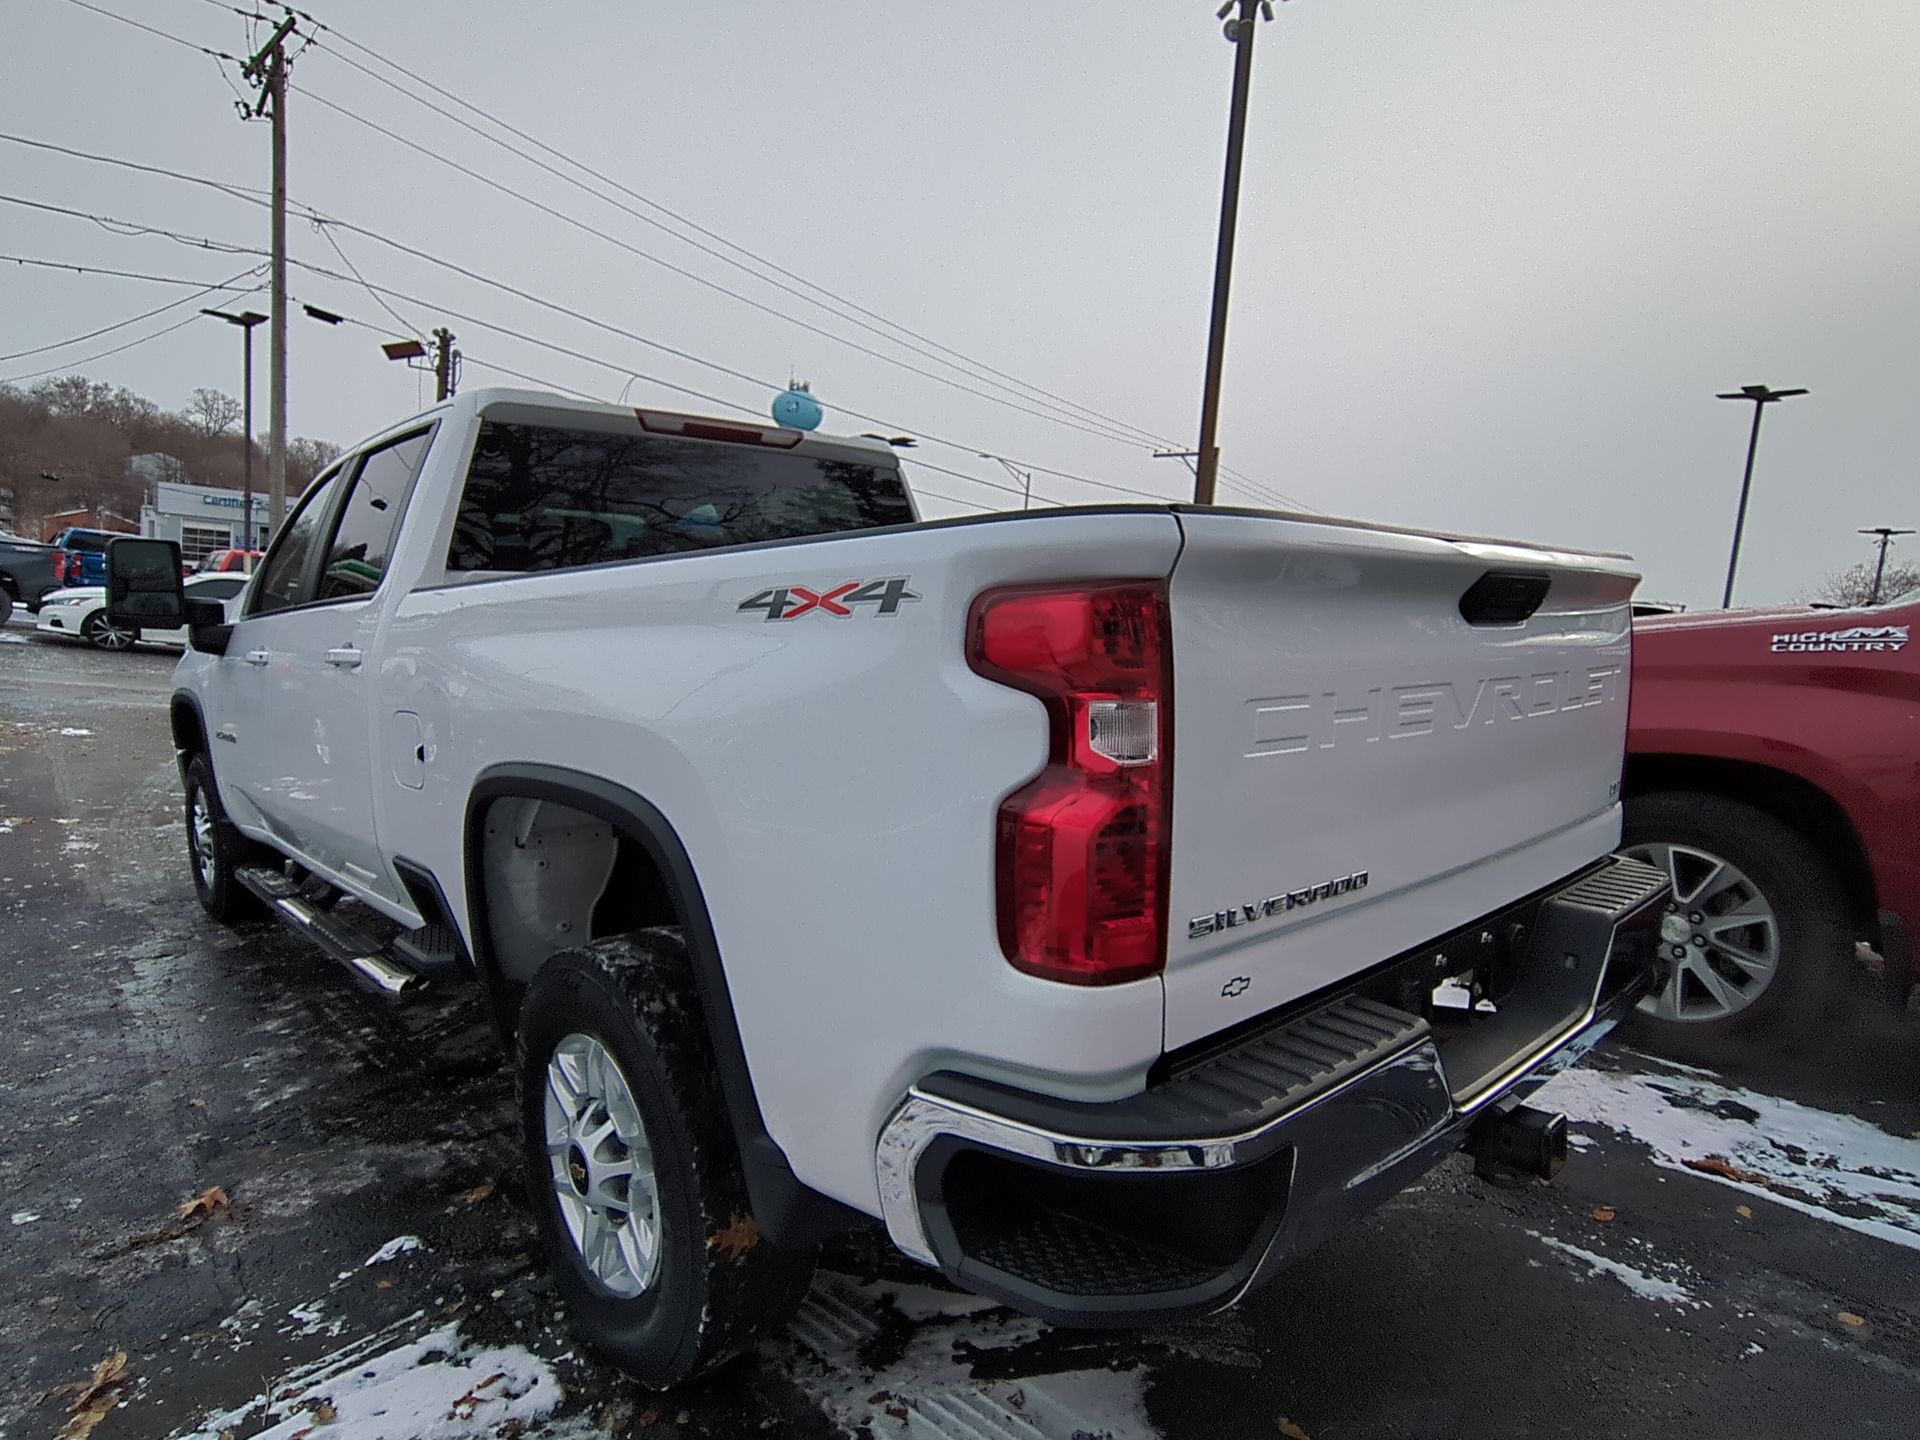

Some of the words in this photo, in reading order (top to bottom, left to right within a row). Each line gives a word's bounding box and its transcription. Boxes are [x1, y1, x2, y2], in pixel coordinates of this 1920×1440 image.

[1771, 632, 1837, 643] HIGH
[1771, 642, 1906, 652] COUNTRY
[1243, 665, 1622, 758] CHEVROLET
[1188, 870, 1369, 938] SILVERADO
